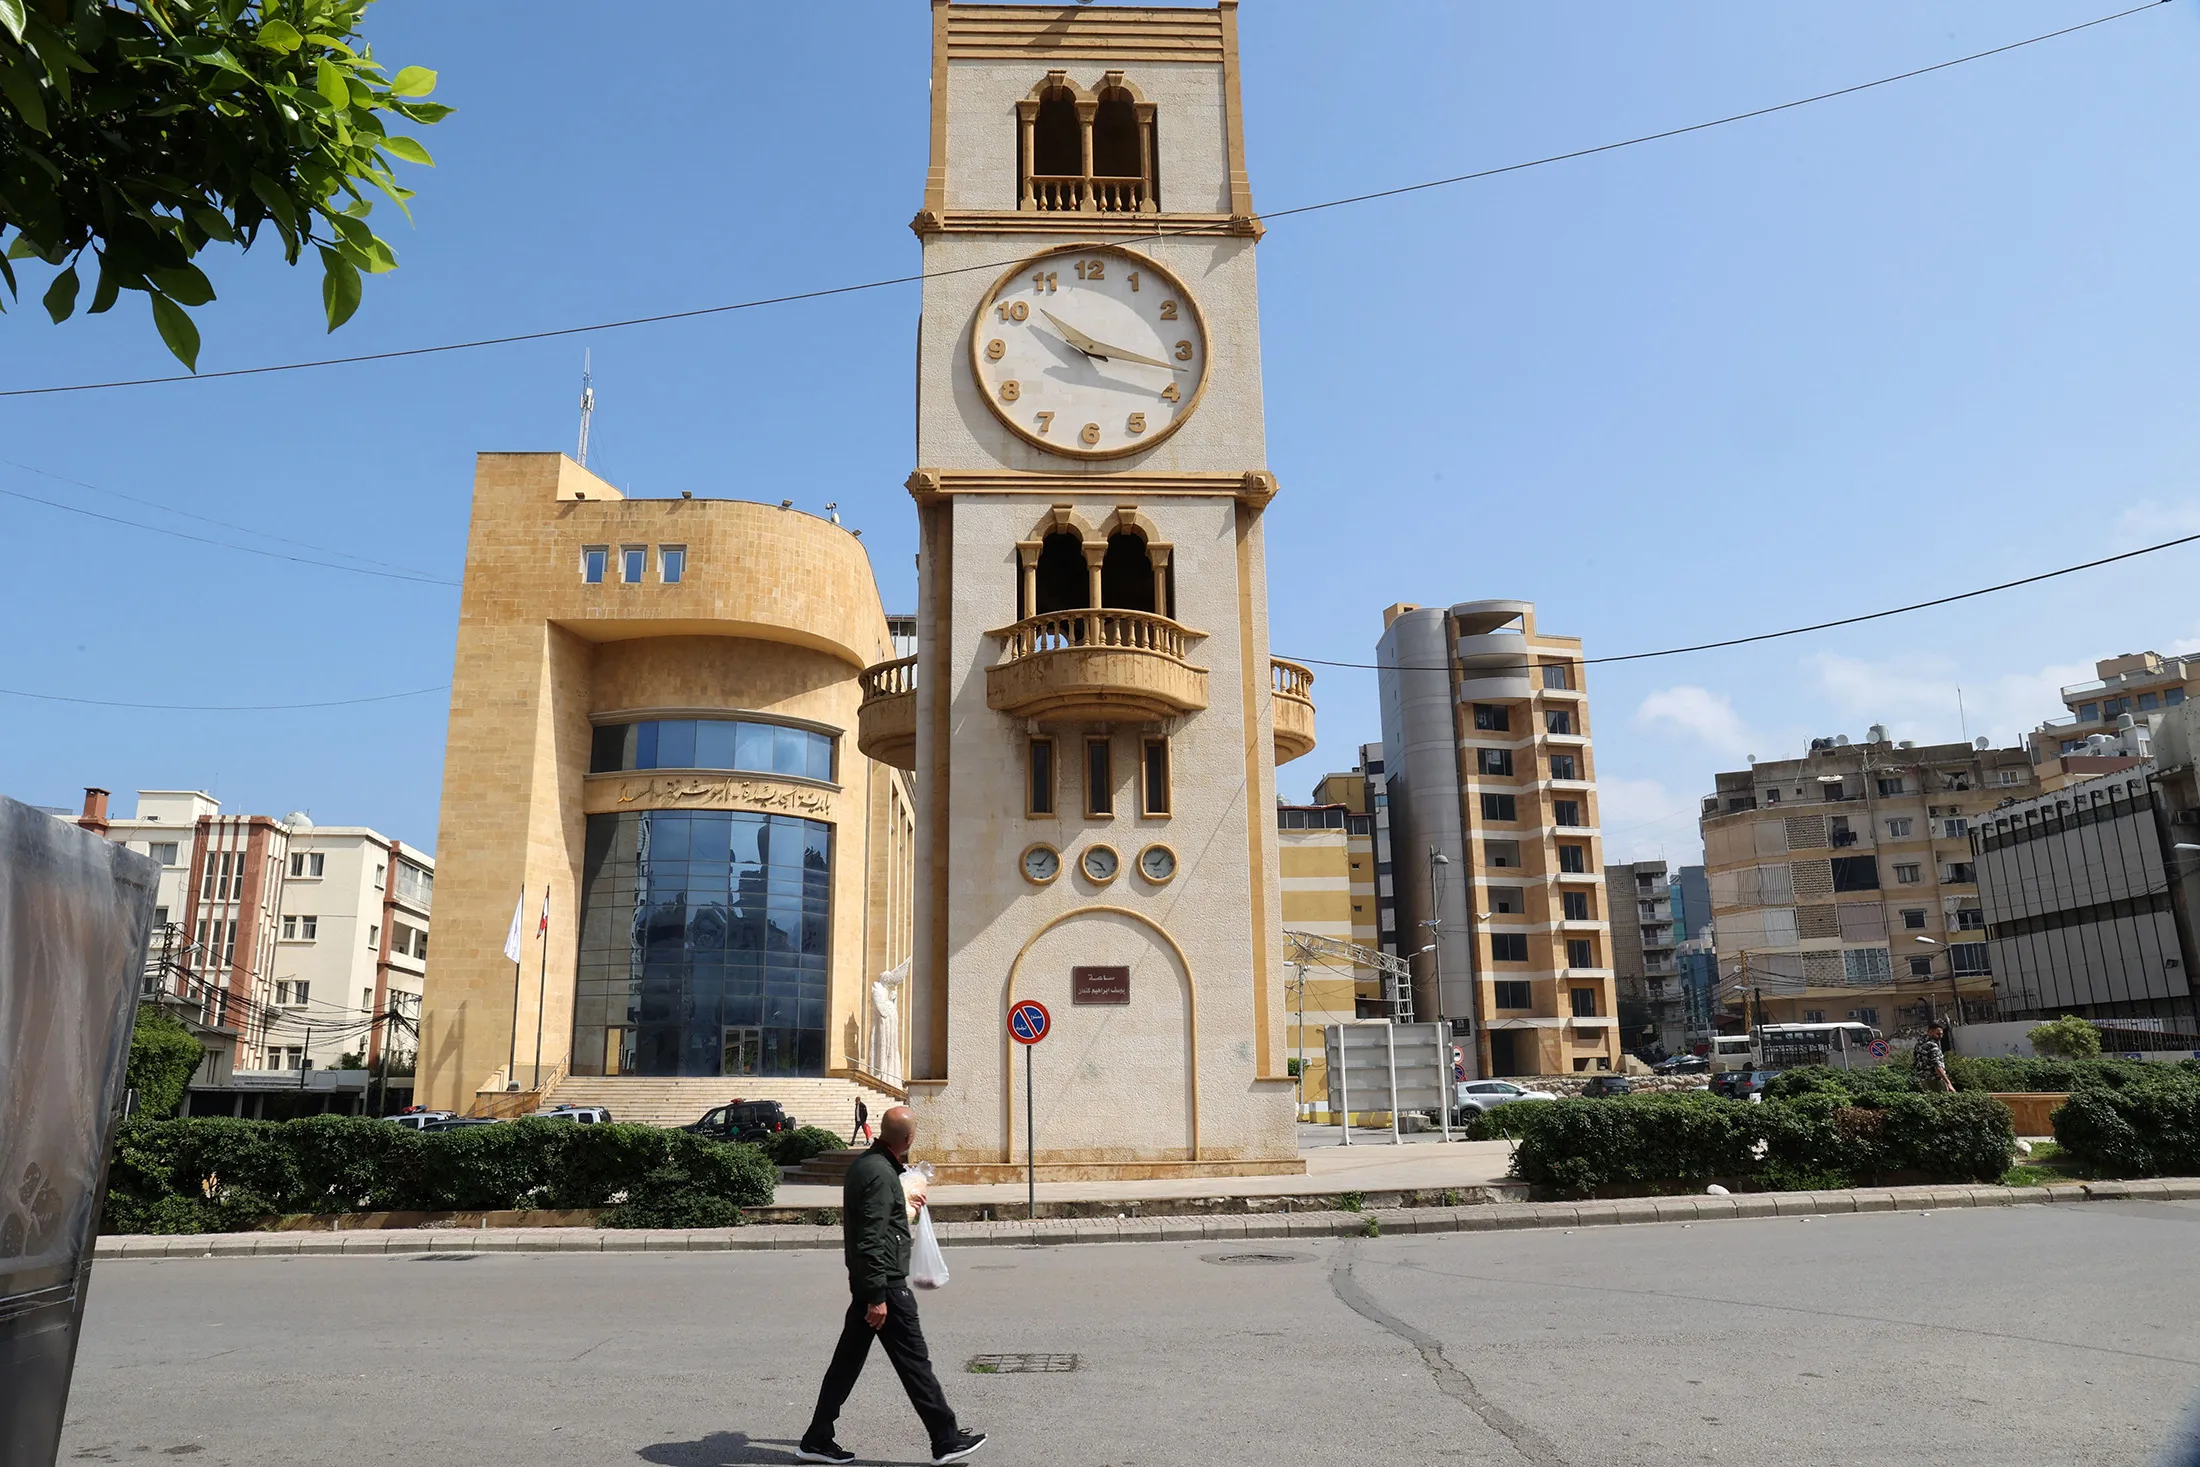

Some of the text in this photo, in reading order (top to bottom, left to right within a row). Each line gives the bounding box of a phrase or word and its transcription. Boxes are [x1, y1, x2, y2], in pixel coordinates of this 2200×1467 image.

[1074, 260, 1105, 280] 12
[1032, 272, 1058, 291] 11
[1127, 272, 1140, 291] 1
[998, 301, 1030, 321] 10
[1160, 300, 1178, 320] 2
[987, 338, 1006, 359] 9
[1175, 340, 1193, 360] 3
[1001, 380, 1020, 401] 8
[1161, 382, 1181, 403] 4
[1036, 411, 1055, 432] 7
[1128, 412, 1147, 433] 5
[1081, 423, 1101, 444] 6
[1087, 973, 1116, 981] ساعة
